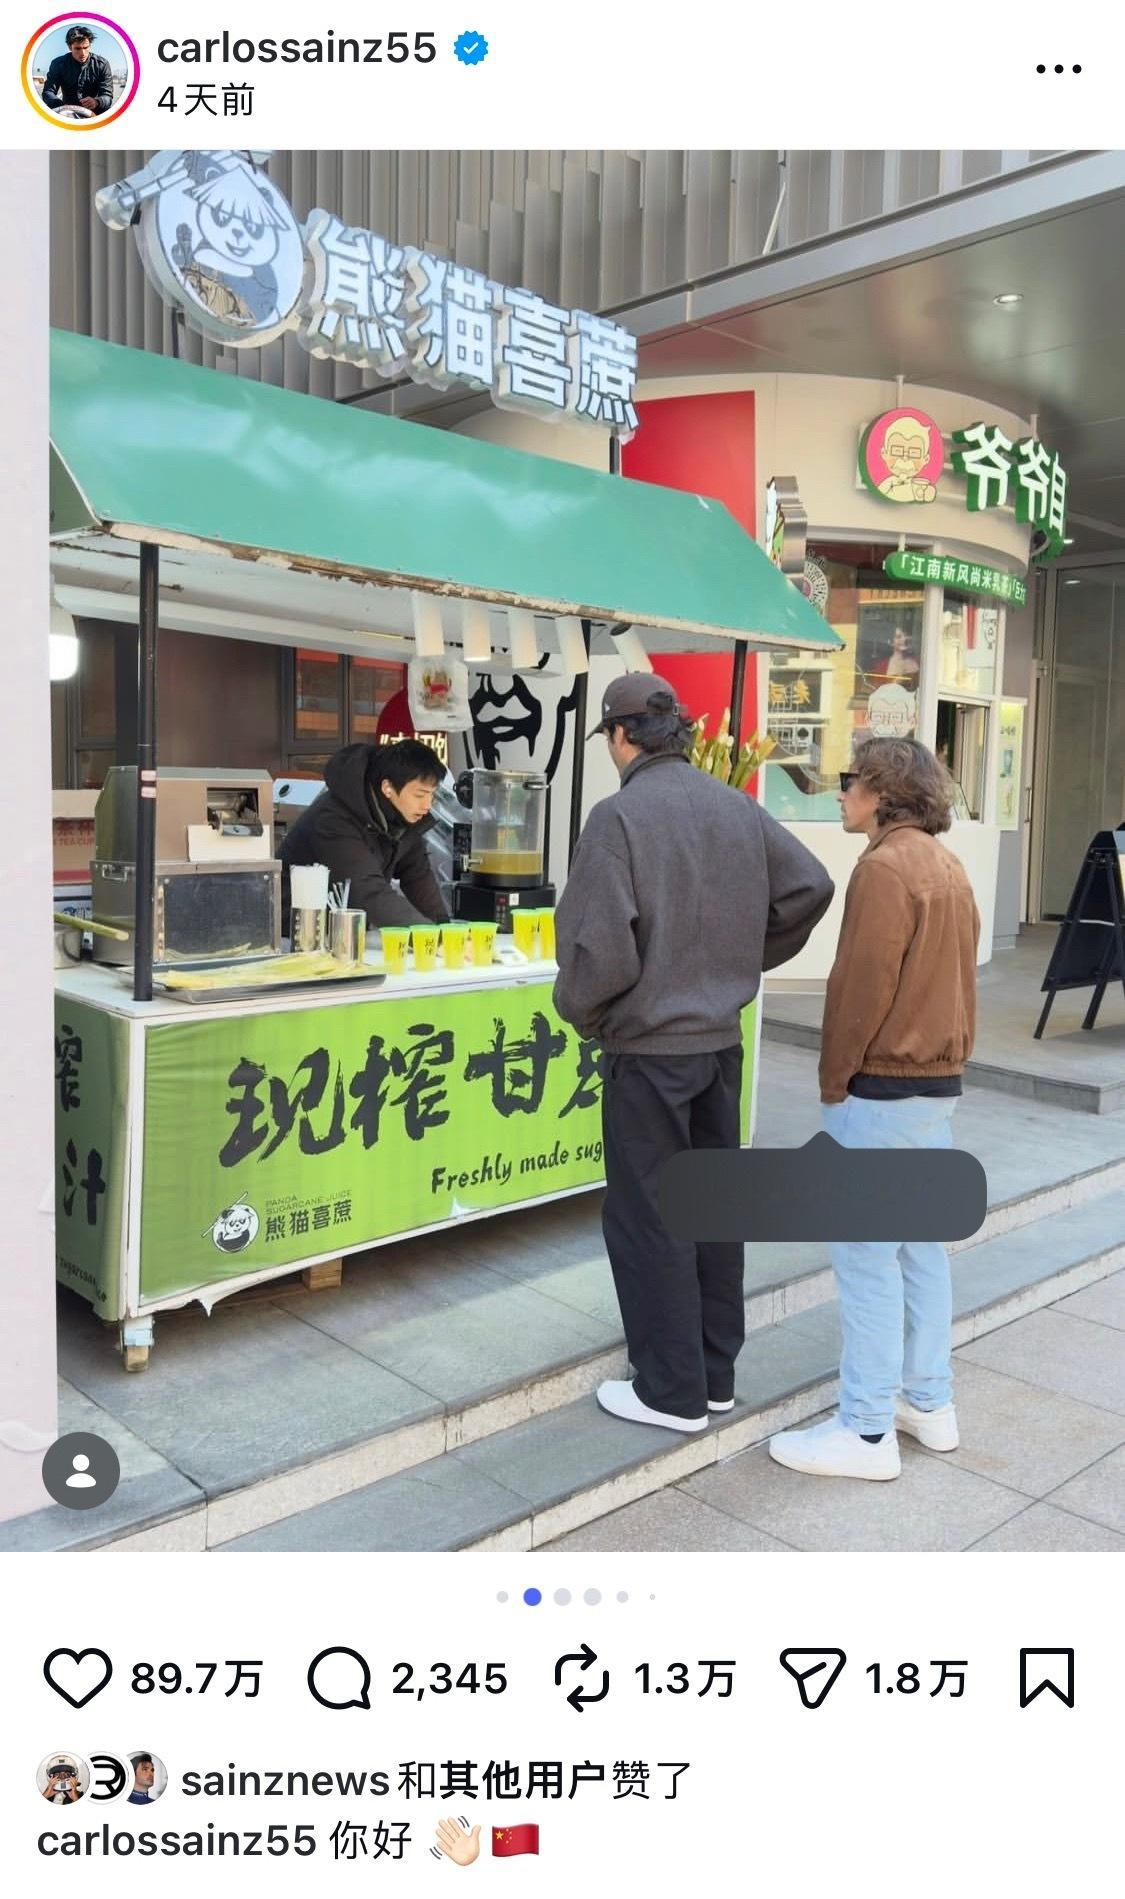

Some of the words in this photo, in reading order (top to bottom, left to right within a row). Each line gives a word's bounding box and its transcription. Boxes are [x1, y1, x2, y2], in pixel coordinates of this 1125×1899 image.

[318, 218, 640, 431] 熊猫喜蔗
[431, 1152, 512, 1195] Freshly
[519, 1140, 569, 1175] made
[265, 1199, 352, 1243] 熊猫喜蔗
